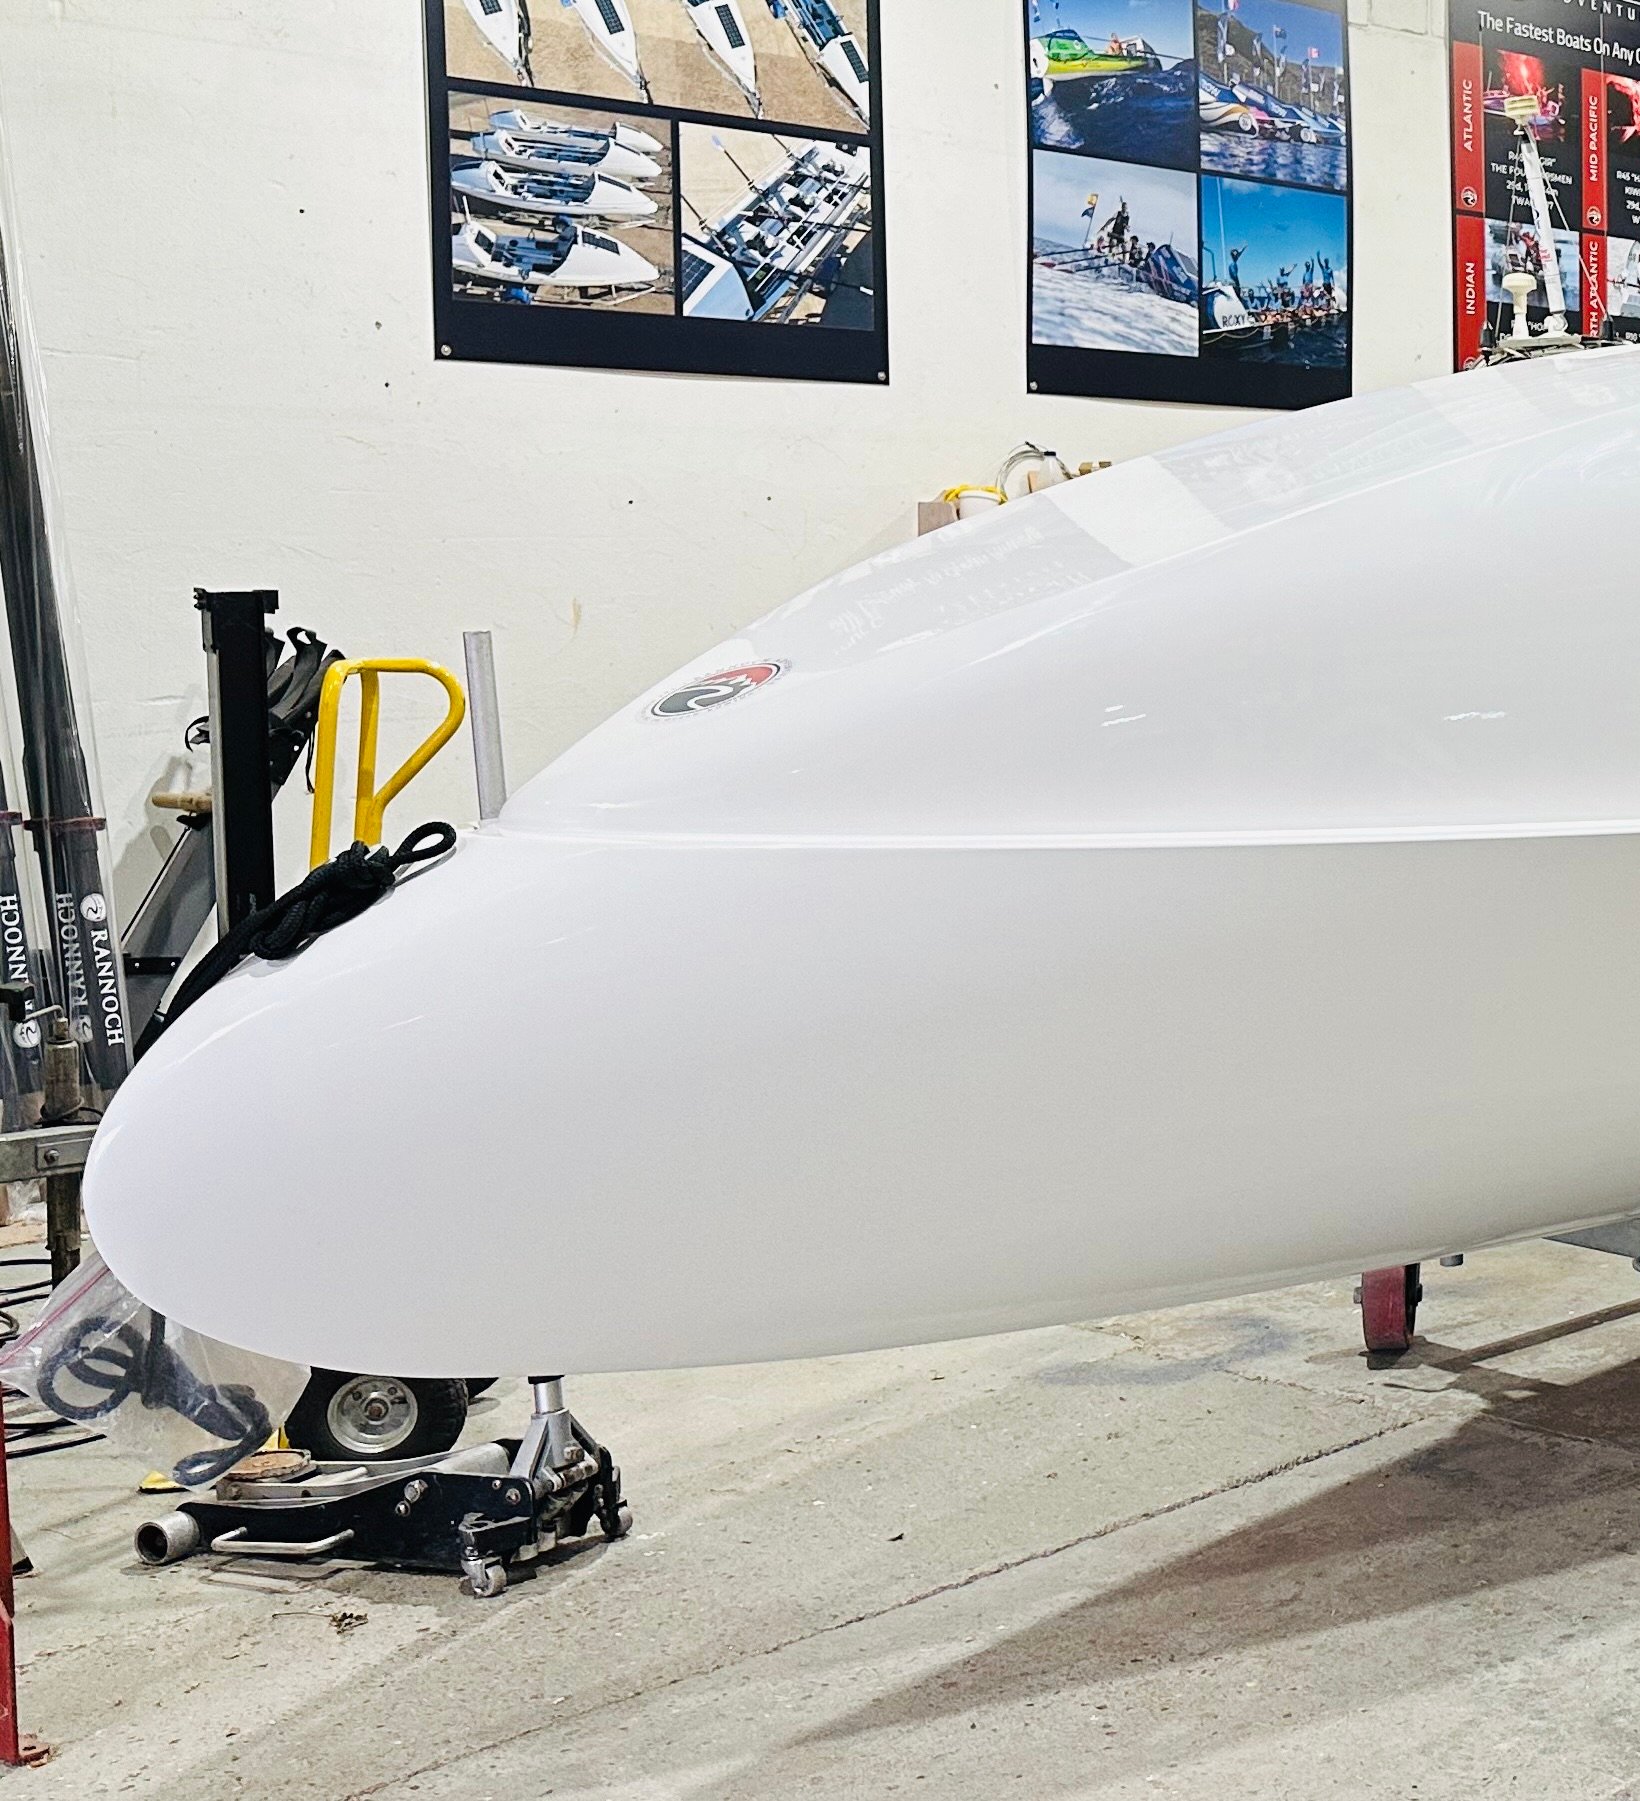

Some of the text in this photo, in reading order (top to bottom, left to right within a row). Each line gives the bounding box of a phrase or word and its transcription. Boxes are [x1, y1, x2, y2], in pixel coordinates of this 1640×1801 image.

[1478, 10, 1503, 32] The
[1506, 17, 1555, 44] Fastest
[1556, 28, 1592, 53] Boats
[1593, 37, 1610, 56] On
[1612, 42, 1634, 66] Any
[1462, 79, 1473, 152] ATLANTIC
[1588, 95, 1599, 182] MID PACIFIC
[1490, 163, 1508, 175] THE
[1465, 262, 1476, 316] INDIAN
[1589, 241, 1599, 309] ATLANTIC
[55, 892, 89, 1007] RANNOCH
[90, 928, 126, 1047] RANNOCH
